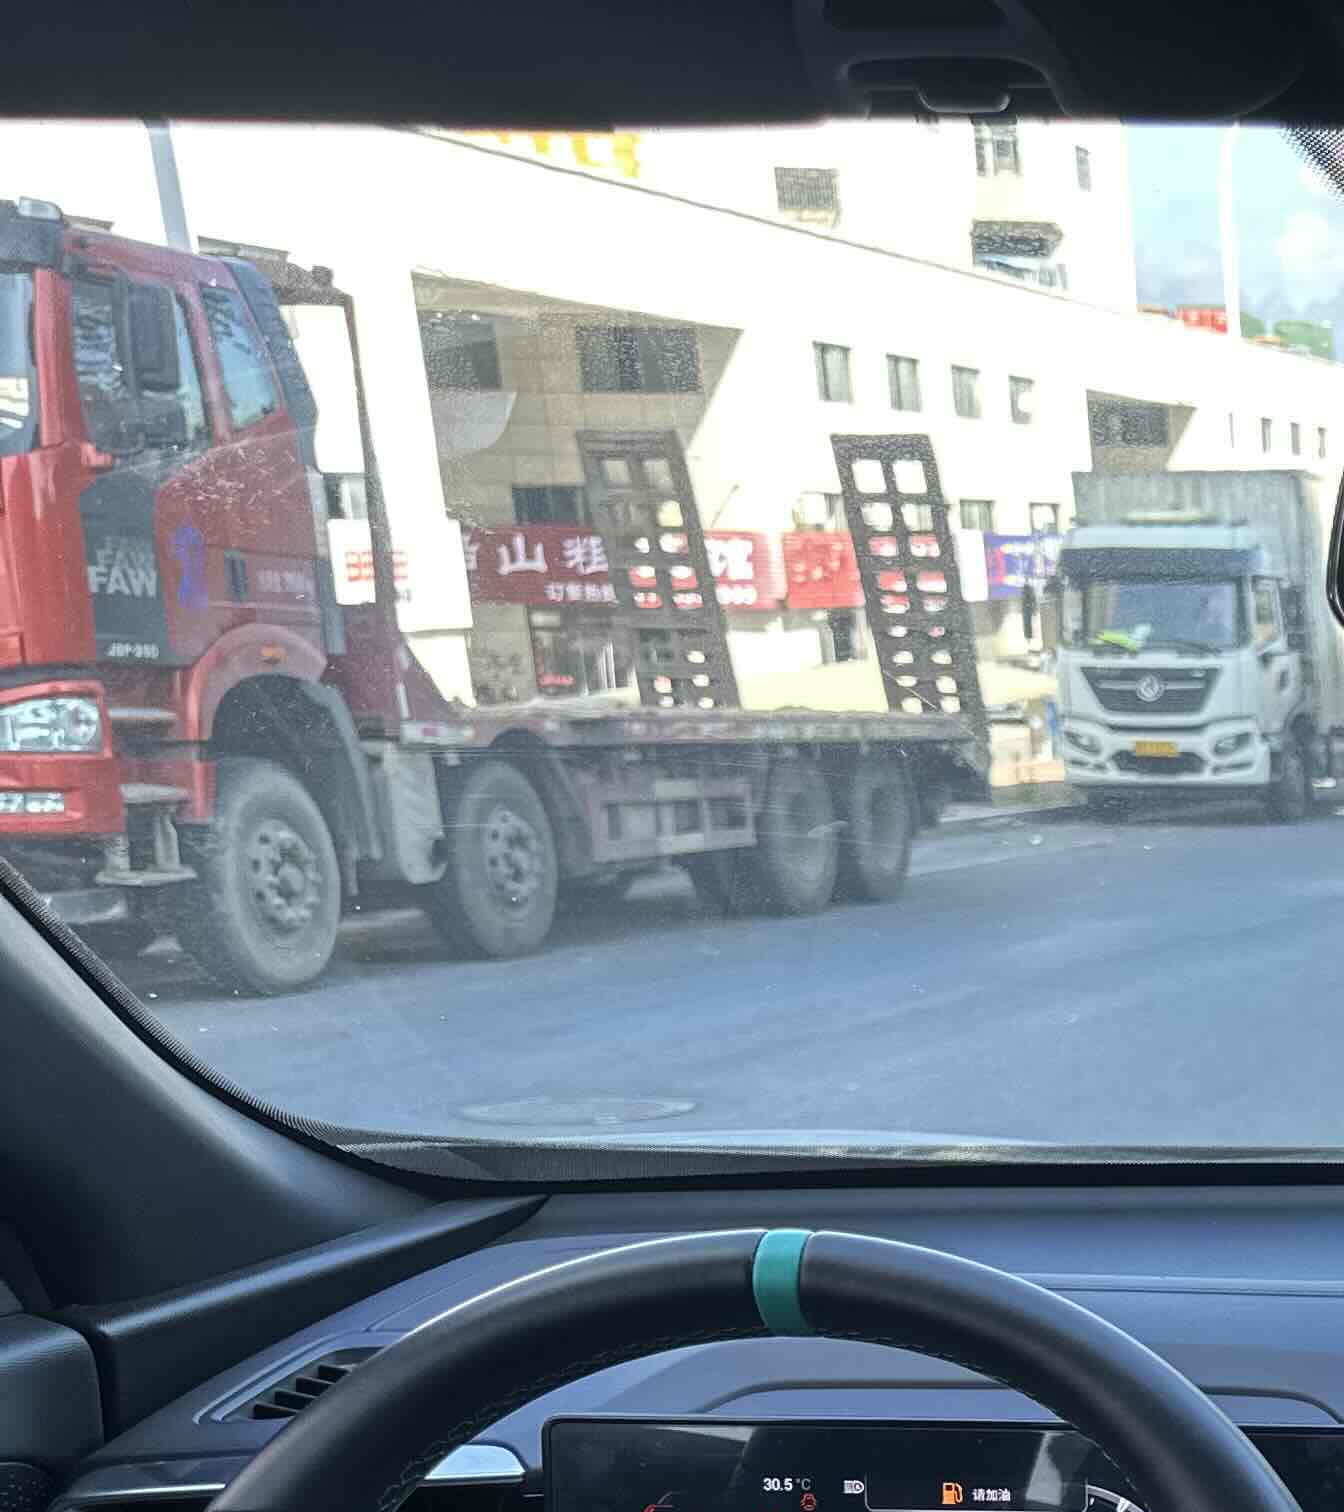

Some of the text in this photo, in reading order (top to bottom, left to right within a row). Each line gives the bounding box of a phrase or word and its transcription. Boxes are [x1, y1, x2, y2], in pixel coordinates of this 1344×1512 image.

[87, 567, 158, 597] FAW
[763, 1478, 793, 1491] 30.5
[972, 1488, 1011, 1502] 请加油
